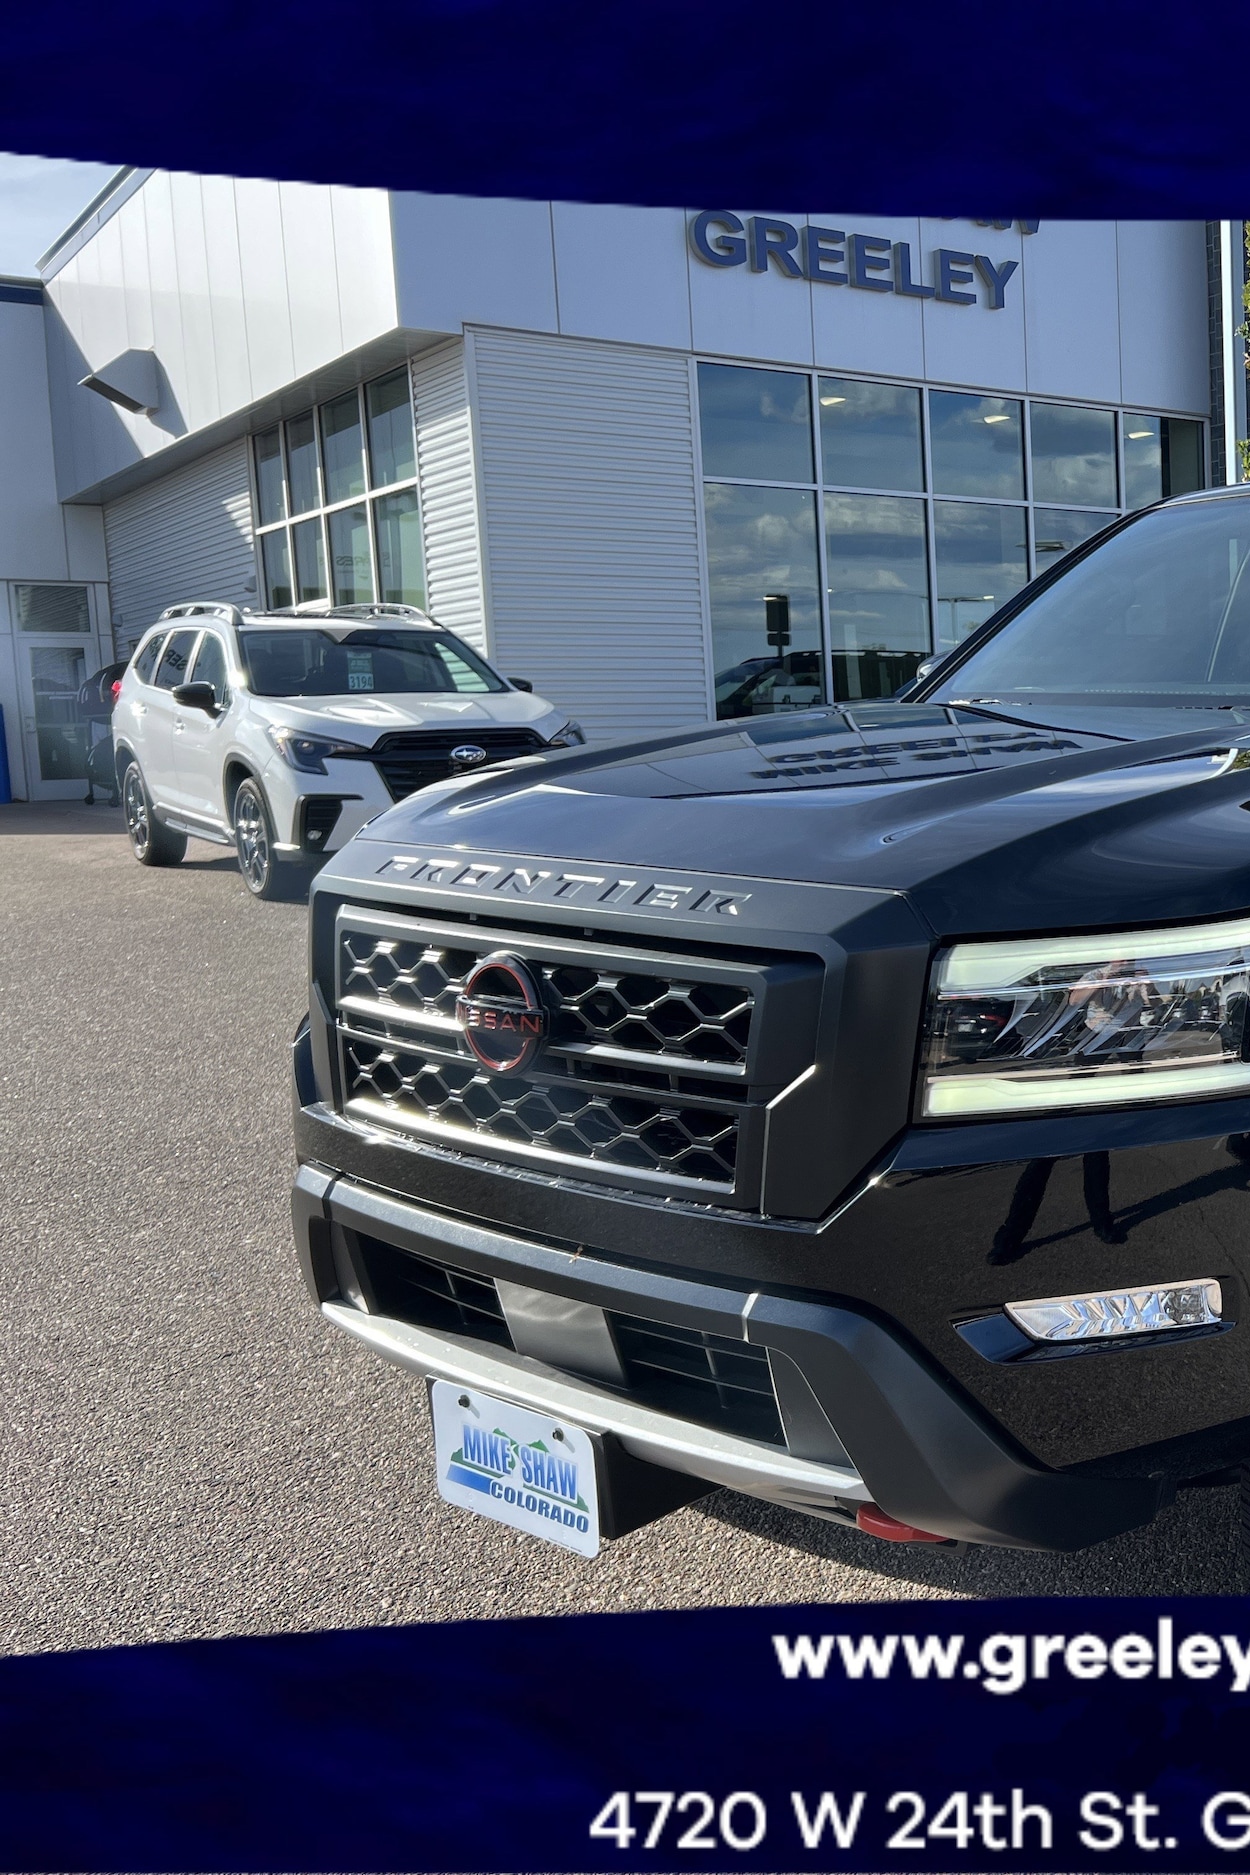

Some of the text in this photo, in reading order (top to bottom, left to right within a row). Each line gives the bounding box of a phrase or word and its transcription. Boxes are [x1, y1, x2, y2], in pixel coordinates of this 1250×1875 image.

[689, 209, 1019, 310] GREELEY
[375, 855, 753, 916] FRONTIER
[463, 1424, 577, 1501] MIKE SHAW
[490, 1481, 590, 1534] COLORADO
